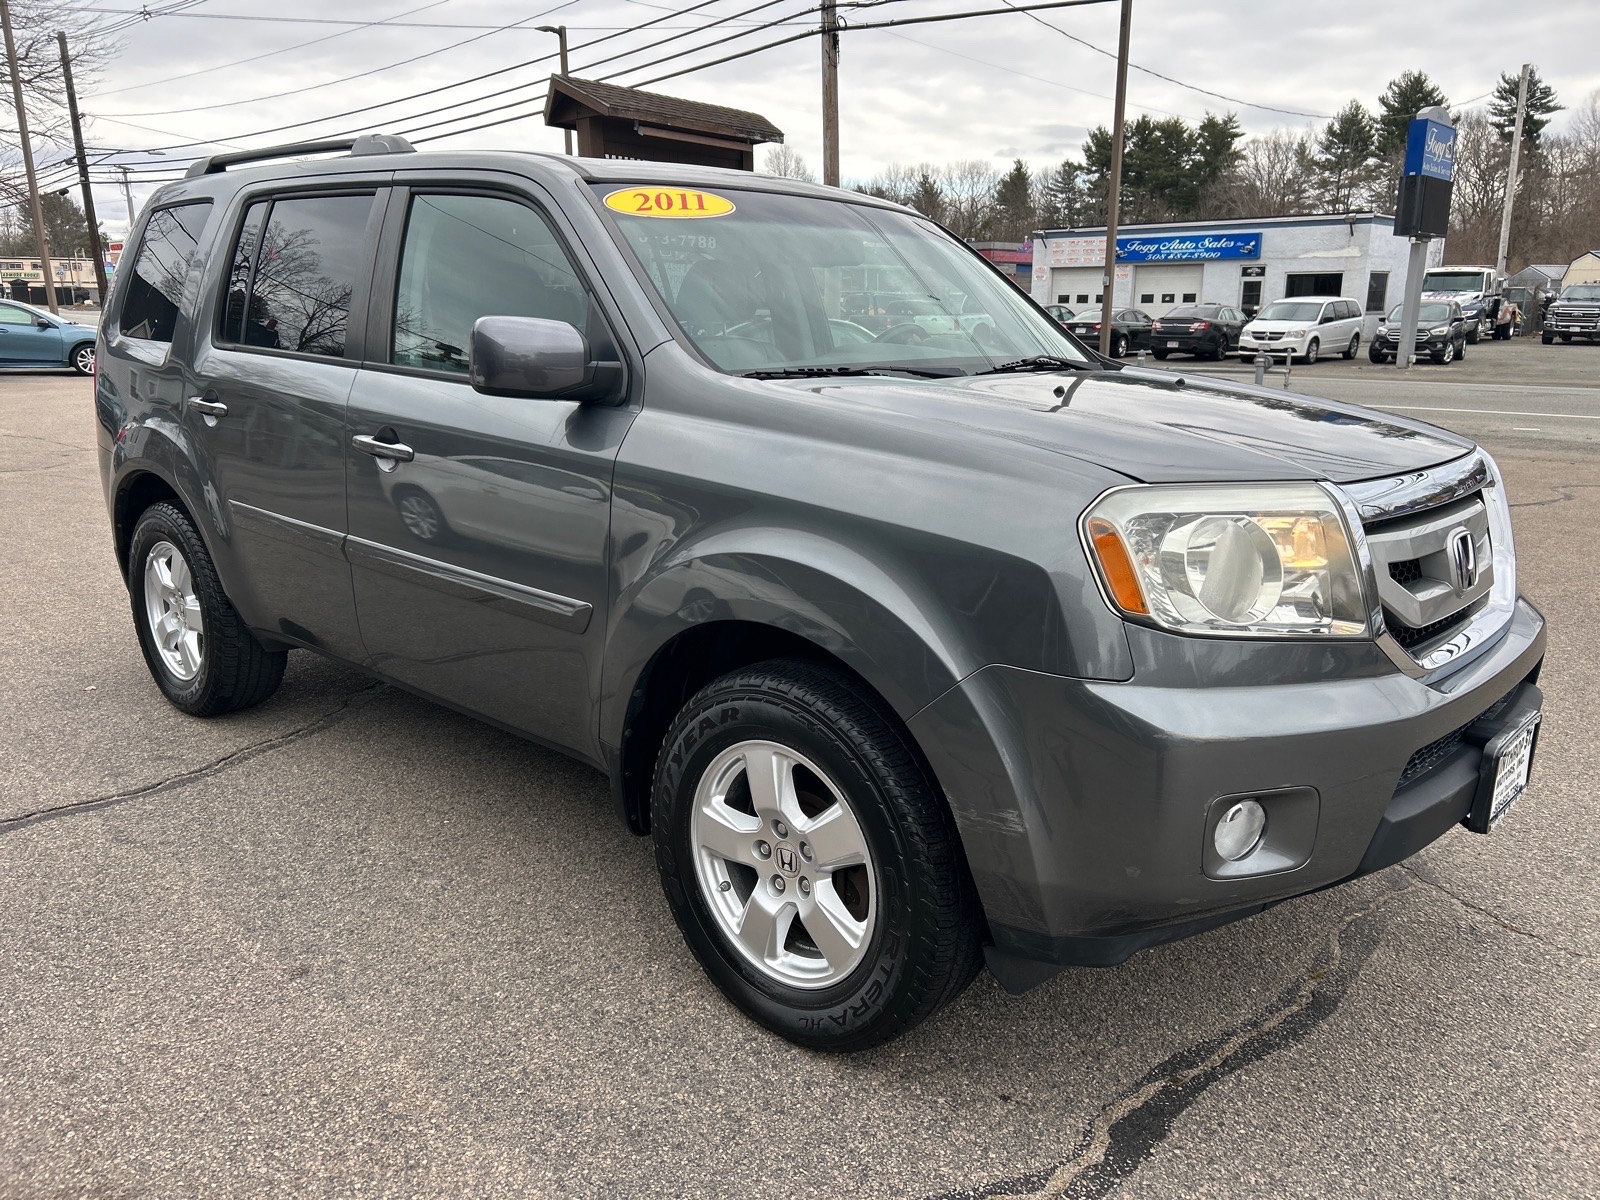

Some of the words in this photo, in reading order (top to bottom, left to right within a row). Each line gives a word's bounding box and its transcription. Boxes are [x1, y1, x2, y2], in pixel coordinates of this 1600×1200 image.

[632, 192, 709, 212] 2011
[1160, 239, 1196, 250] Auto
[1197, 237, 1235, 249] Sales
[1145, 253, 1166, 261] 508
